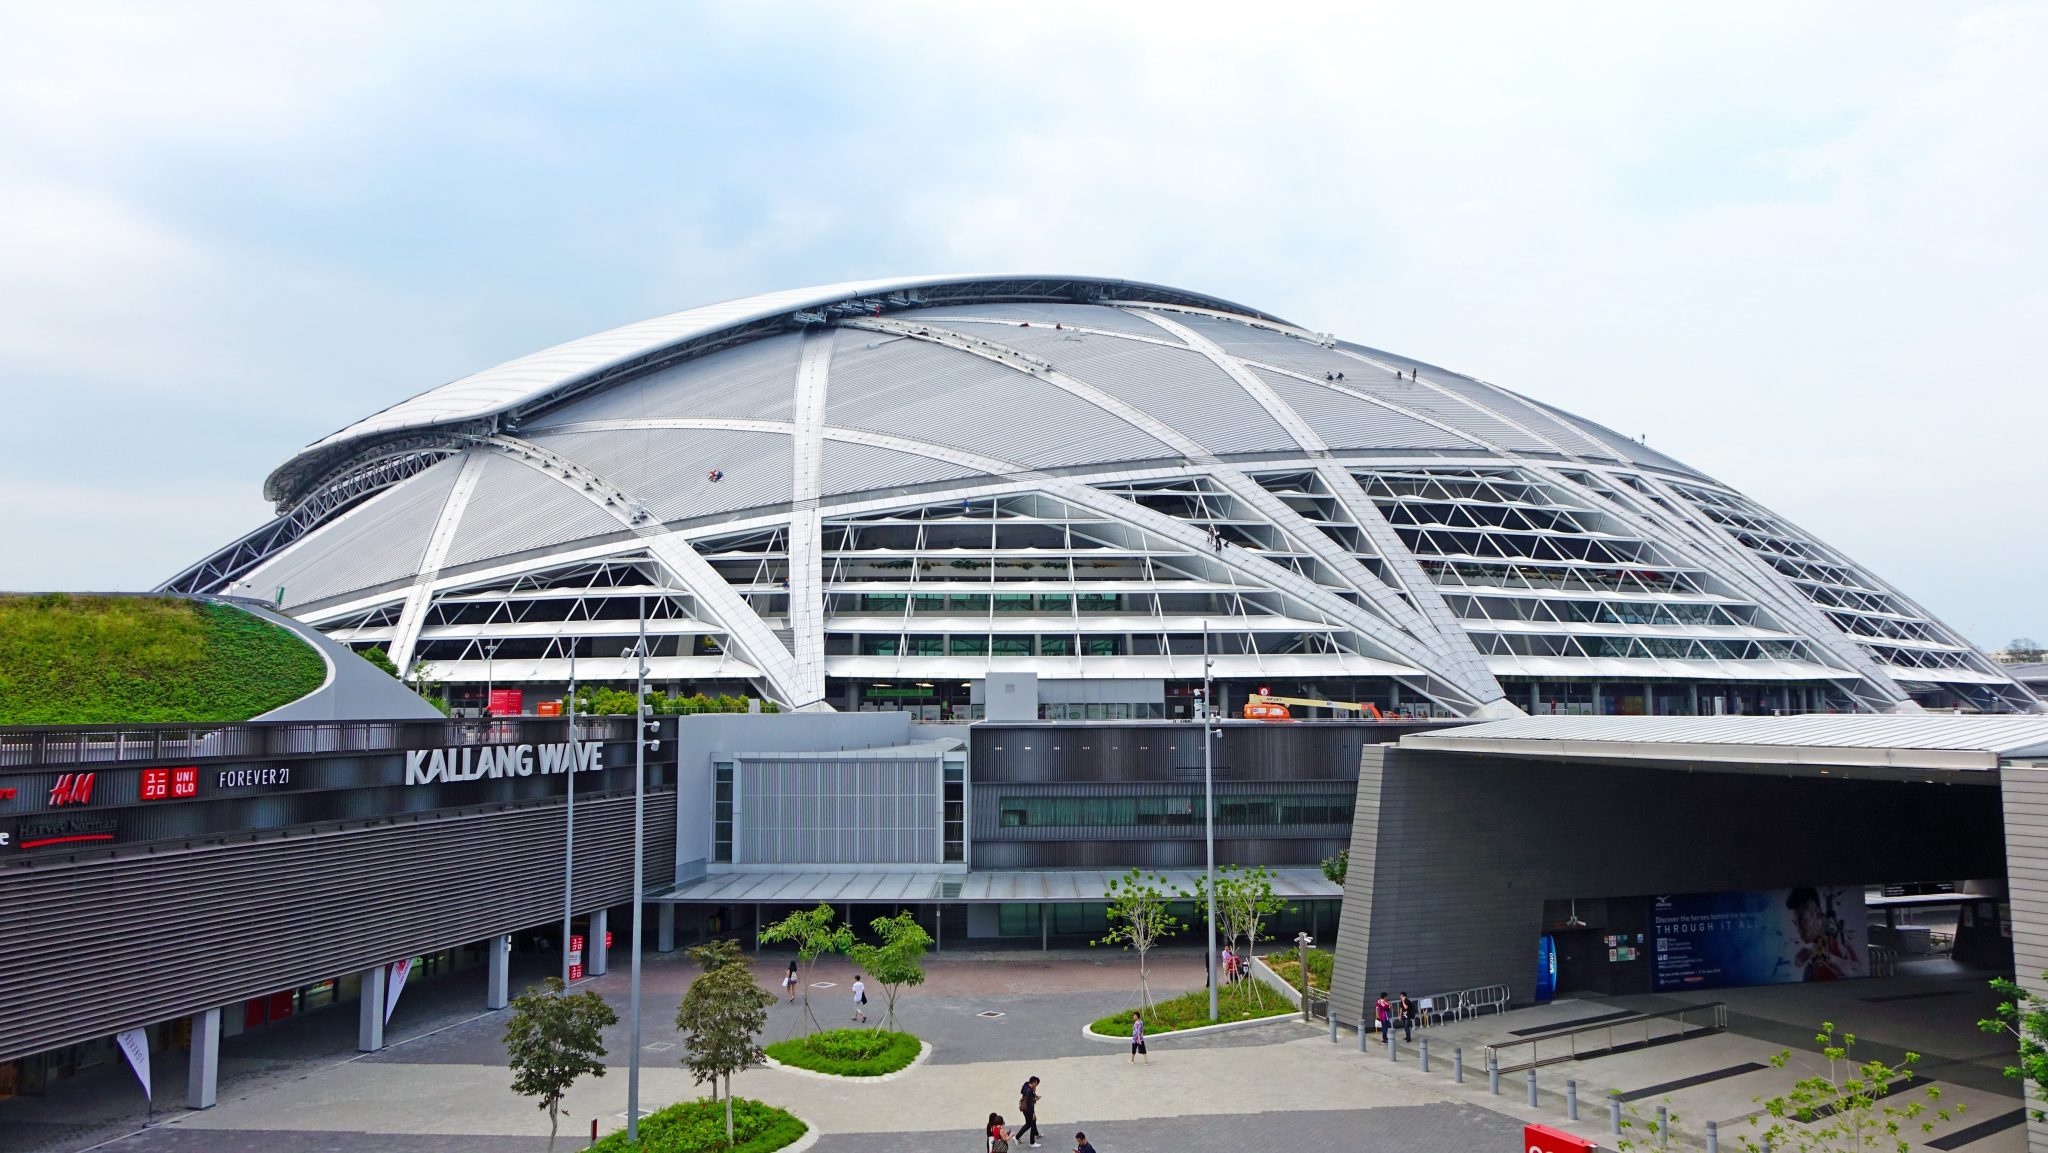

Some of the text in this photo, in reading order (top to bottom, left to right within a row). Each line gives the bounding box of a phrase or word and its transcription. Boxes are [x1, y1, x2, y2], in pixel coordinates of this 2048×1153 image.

[405, 742, 603, 785] KALLANG WAVE
[176, 772, 194, 782] UNI
[219, 768, 290, 788] FOREVER 21
[49, 773, 96, 806] H&M
[175, 783, 194, 794] QLO
[1656, 922, 1714, 934] THROUGH
[1721, 921, 1732, 931] IT
